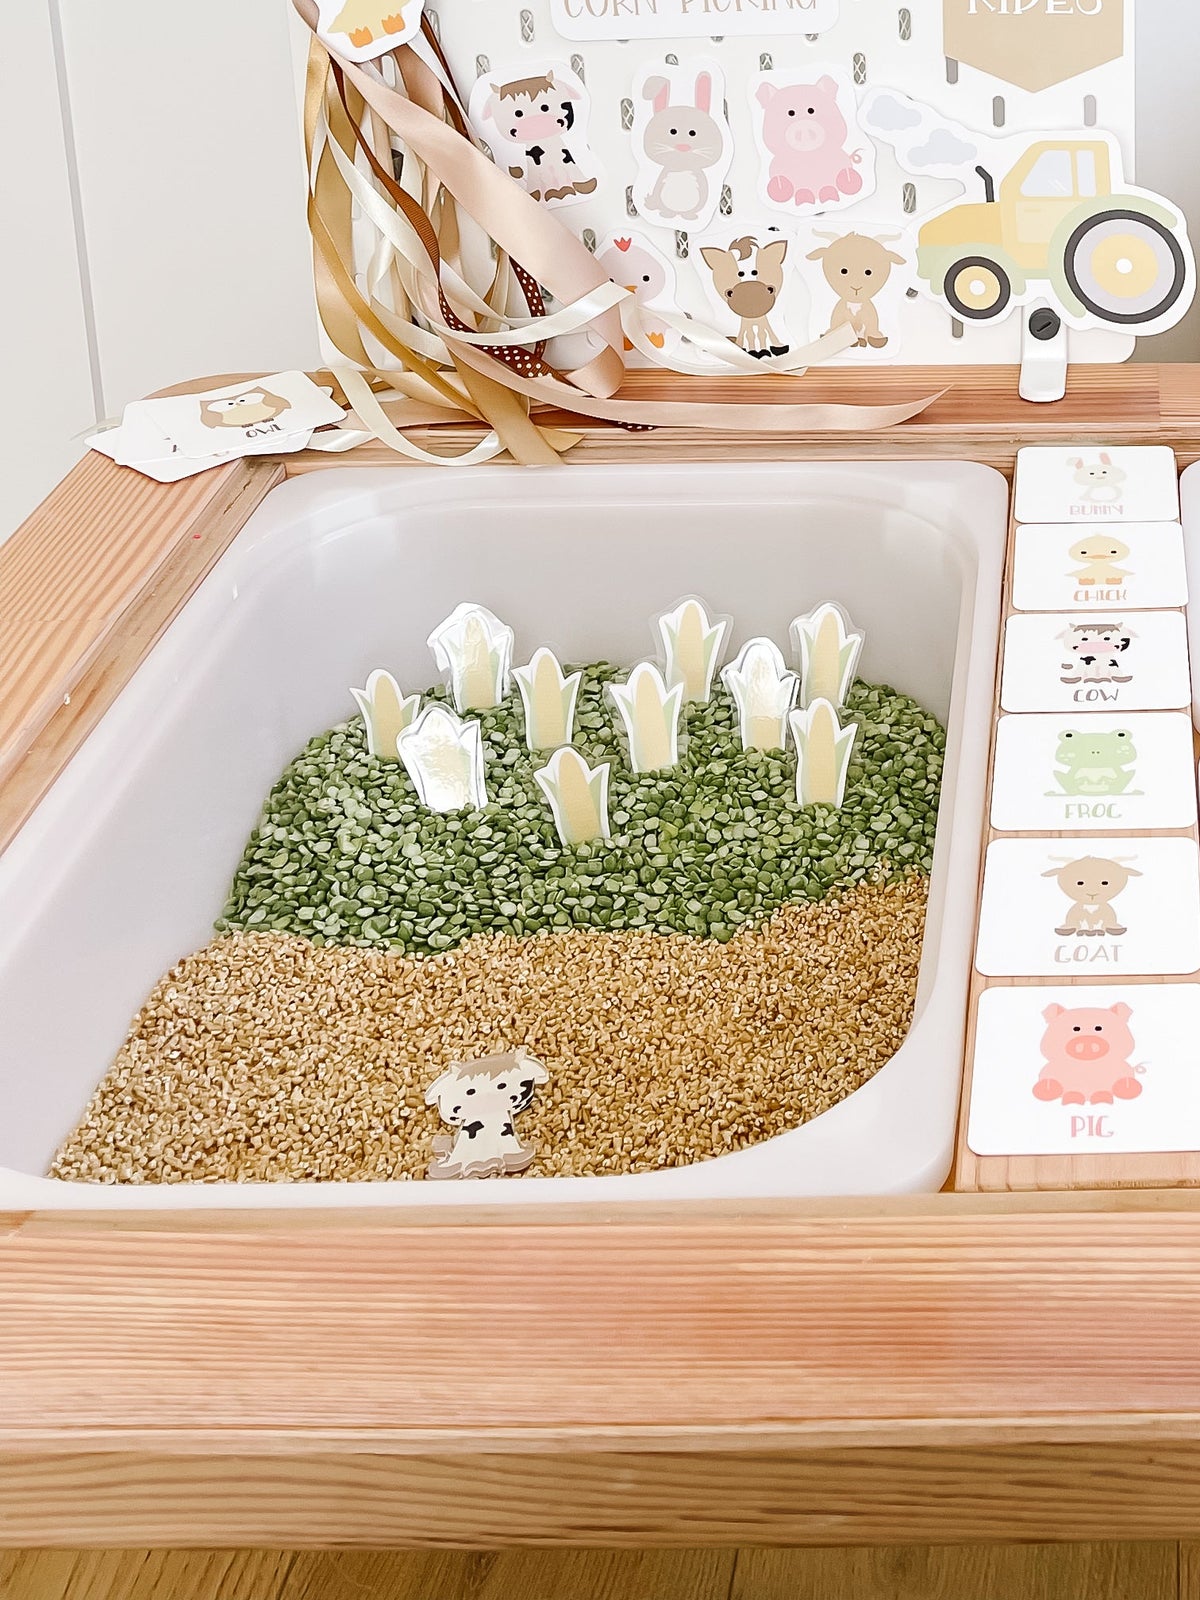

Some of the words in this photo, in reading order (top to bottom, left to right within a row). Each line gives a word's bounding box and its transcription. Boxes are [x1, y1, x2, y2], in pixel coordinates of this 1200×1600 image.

[245, 424, 286, 438] OWL
[1069, 504, 1124, 515] BUNNY
[1073, 589, 1128, 602] CHICK
[1073, 688, 1119, 702] COW
[1064, 803, 1123, 819] FROG
[1054, 944, 1124, 964] GOAT
[1070, 1115, 1114, 1138] PIG
